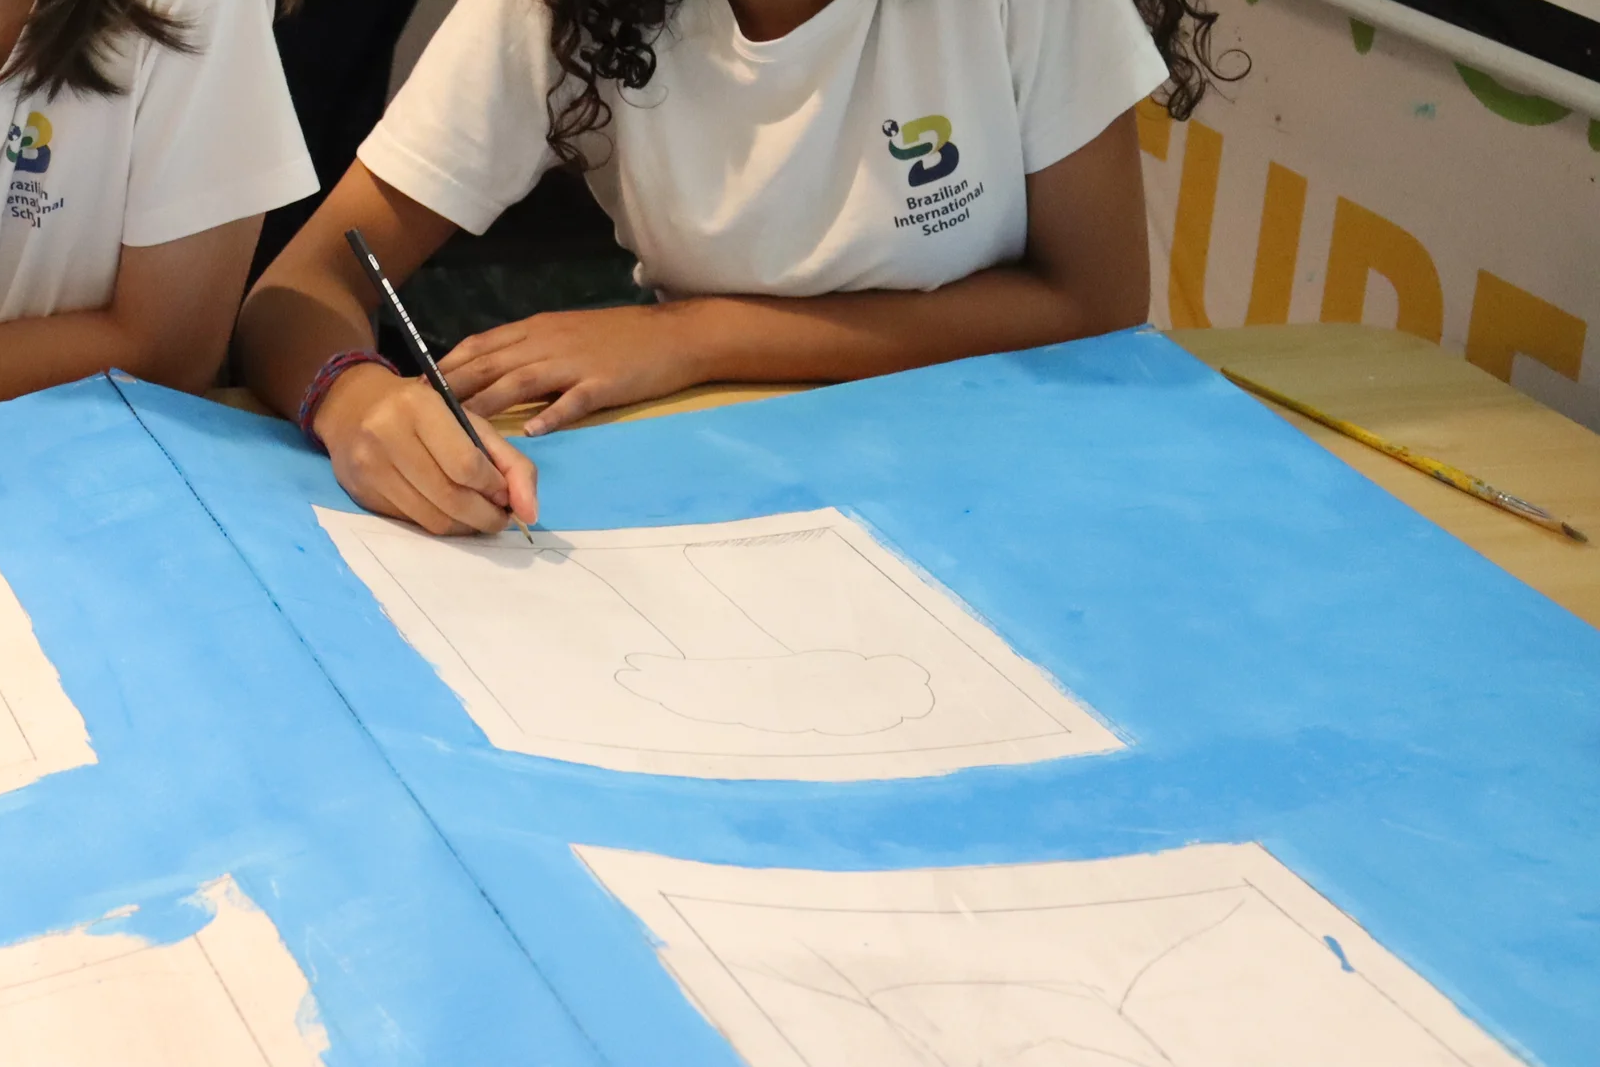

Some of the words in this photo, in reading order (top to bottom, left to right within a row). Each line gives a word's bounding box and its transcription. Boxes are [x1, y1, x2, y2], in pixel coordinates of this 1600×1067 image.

[894, 182, 985, 228] International
[906, 179, 969, 211] Brazilian
[922, 208, 971, 236] School
